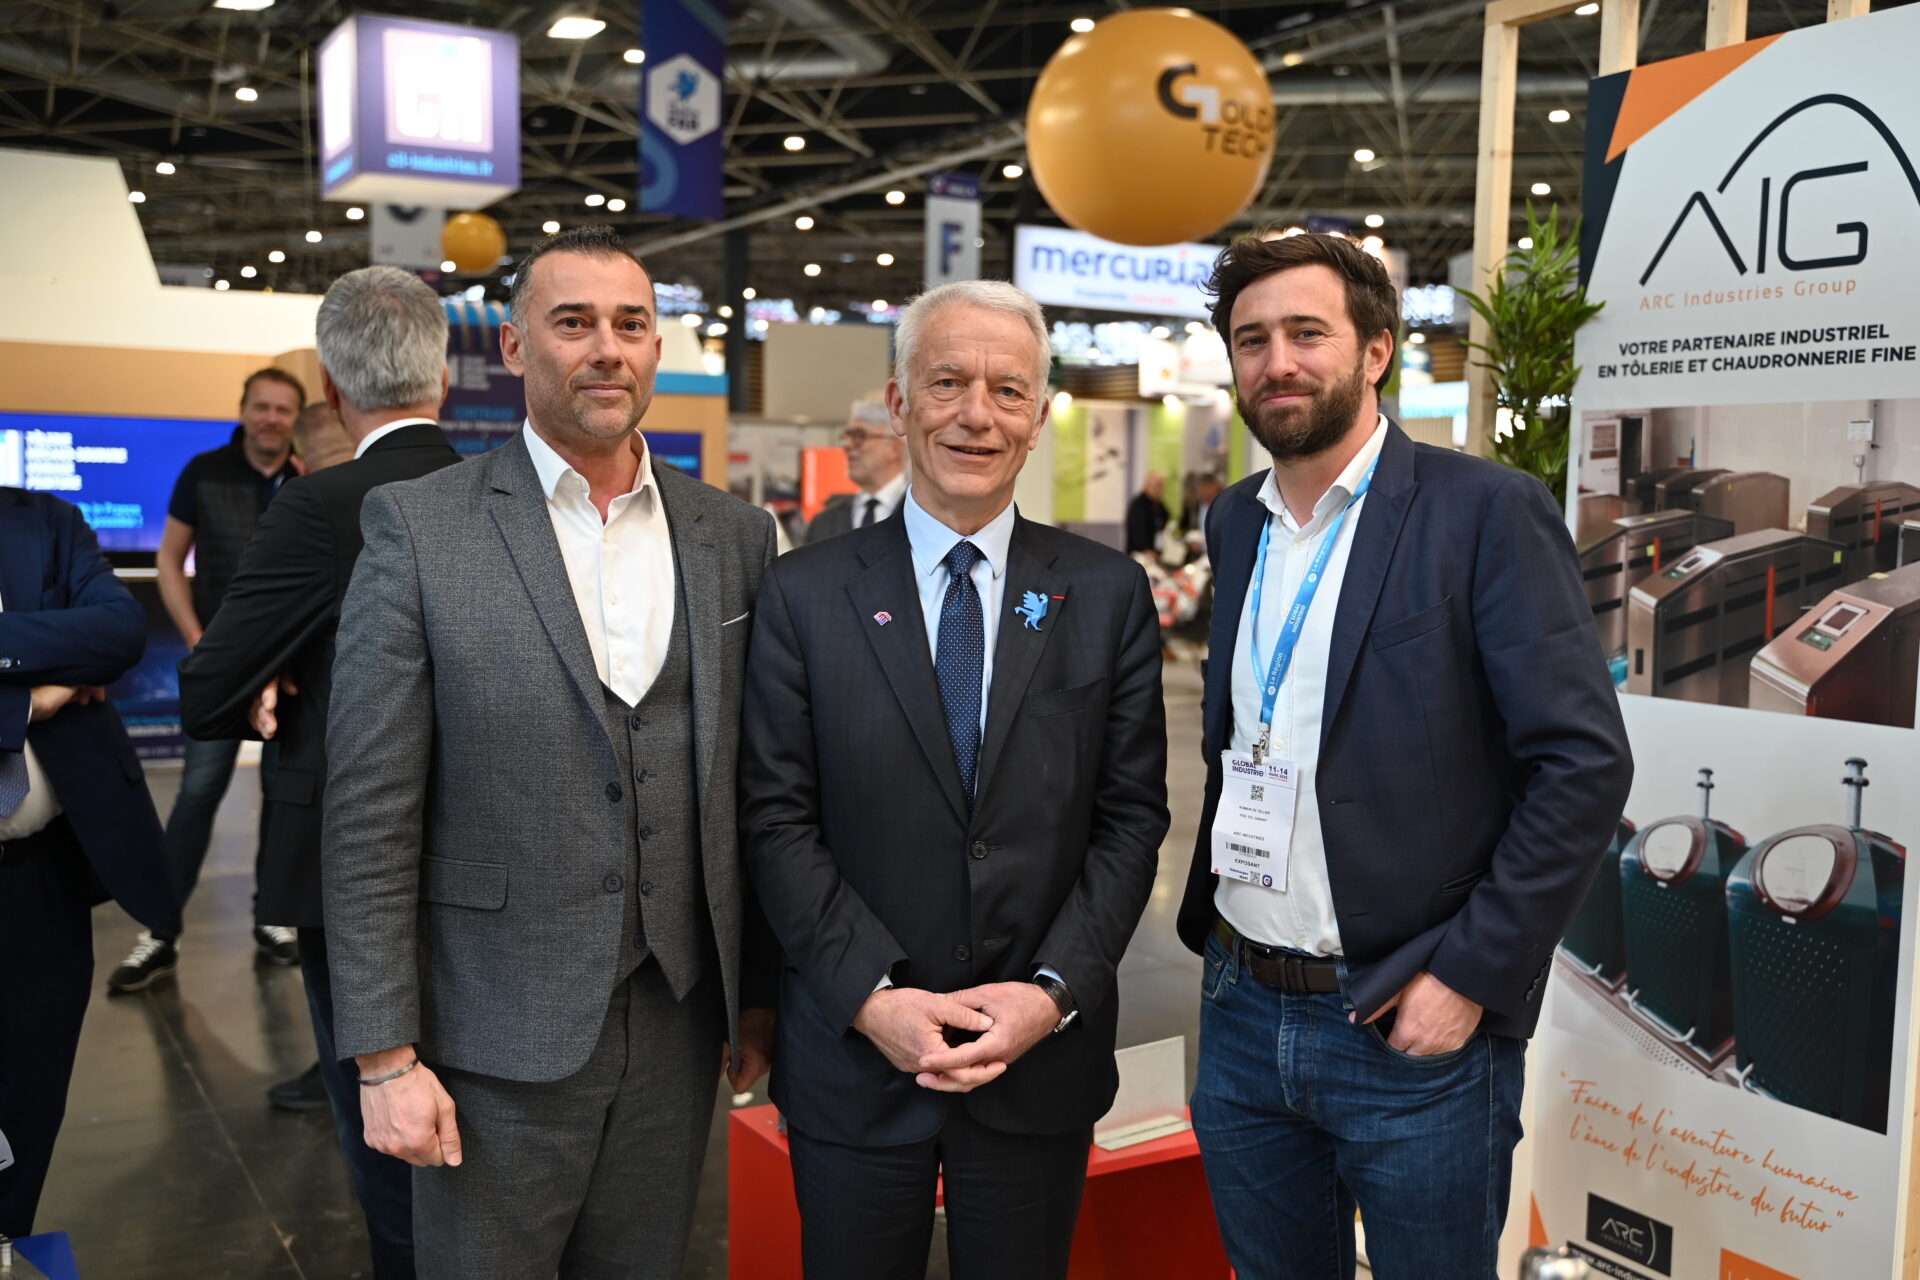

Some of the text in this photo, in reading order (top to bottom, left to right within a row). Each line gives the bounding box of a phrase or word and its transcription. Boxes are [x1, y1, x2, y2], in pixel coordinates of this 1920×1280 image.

[1639, 161, 1868, 287] AIG
[940, 221, 962, 276] F
[1639, 277, 1857, 311] ARC Industries Group
[1619, 323, 1890, 356] VOTRE PARTENAIRE INDUSTRIEL
[1598, 345, 1917, 378] EN TÔLERIE ET CHAUDRONNERIE FINE
[1232, 760, 1256, 769] GLOBAL
[1268, 765, 1288, 775] 11-14
[1234, 858, 1260, 868] EXPOSANT
[1627, 1102, 1648, 1129] de
[1762, 1149, 1859, 1200] humaine
[1623, 1138, 1642, 1166] de
[1751, 1186, 1776, 1216] du
[1601, 1217, 1645, 1248] ARC
